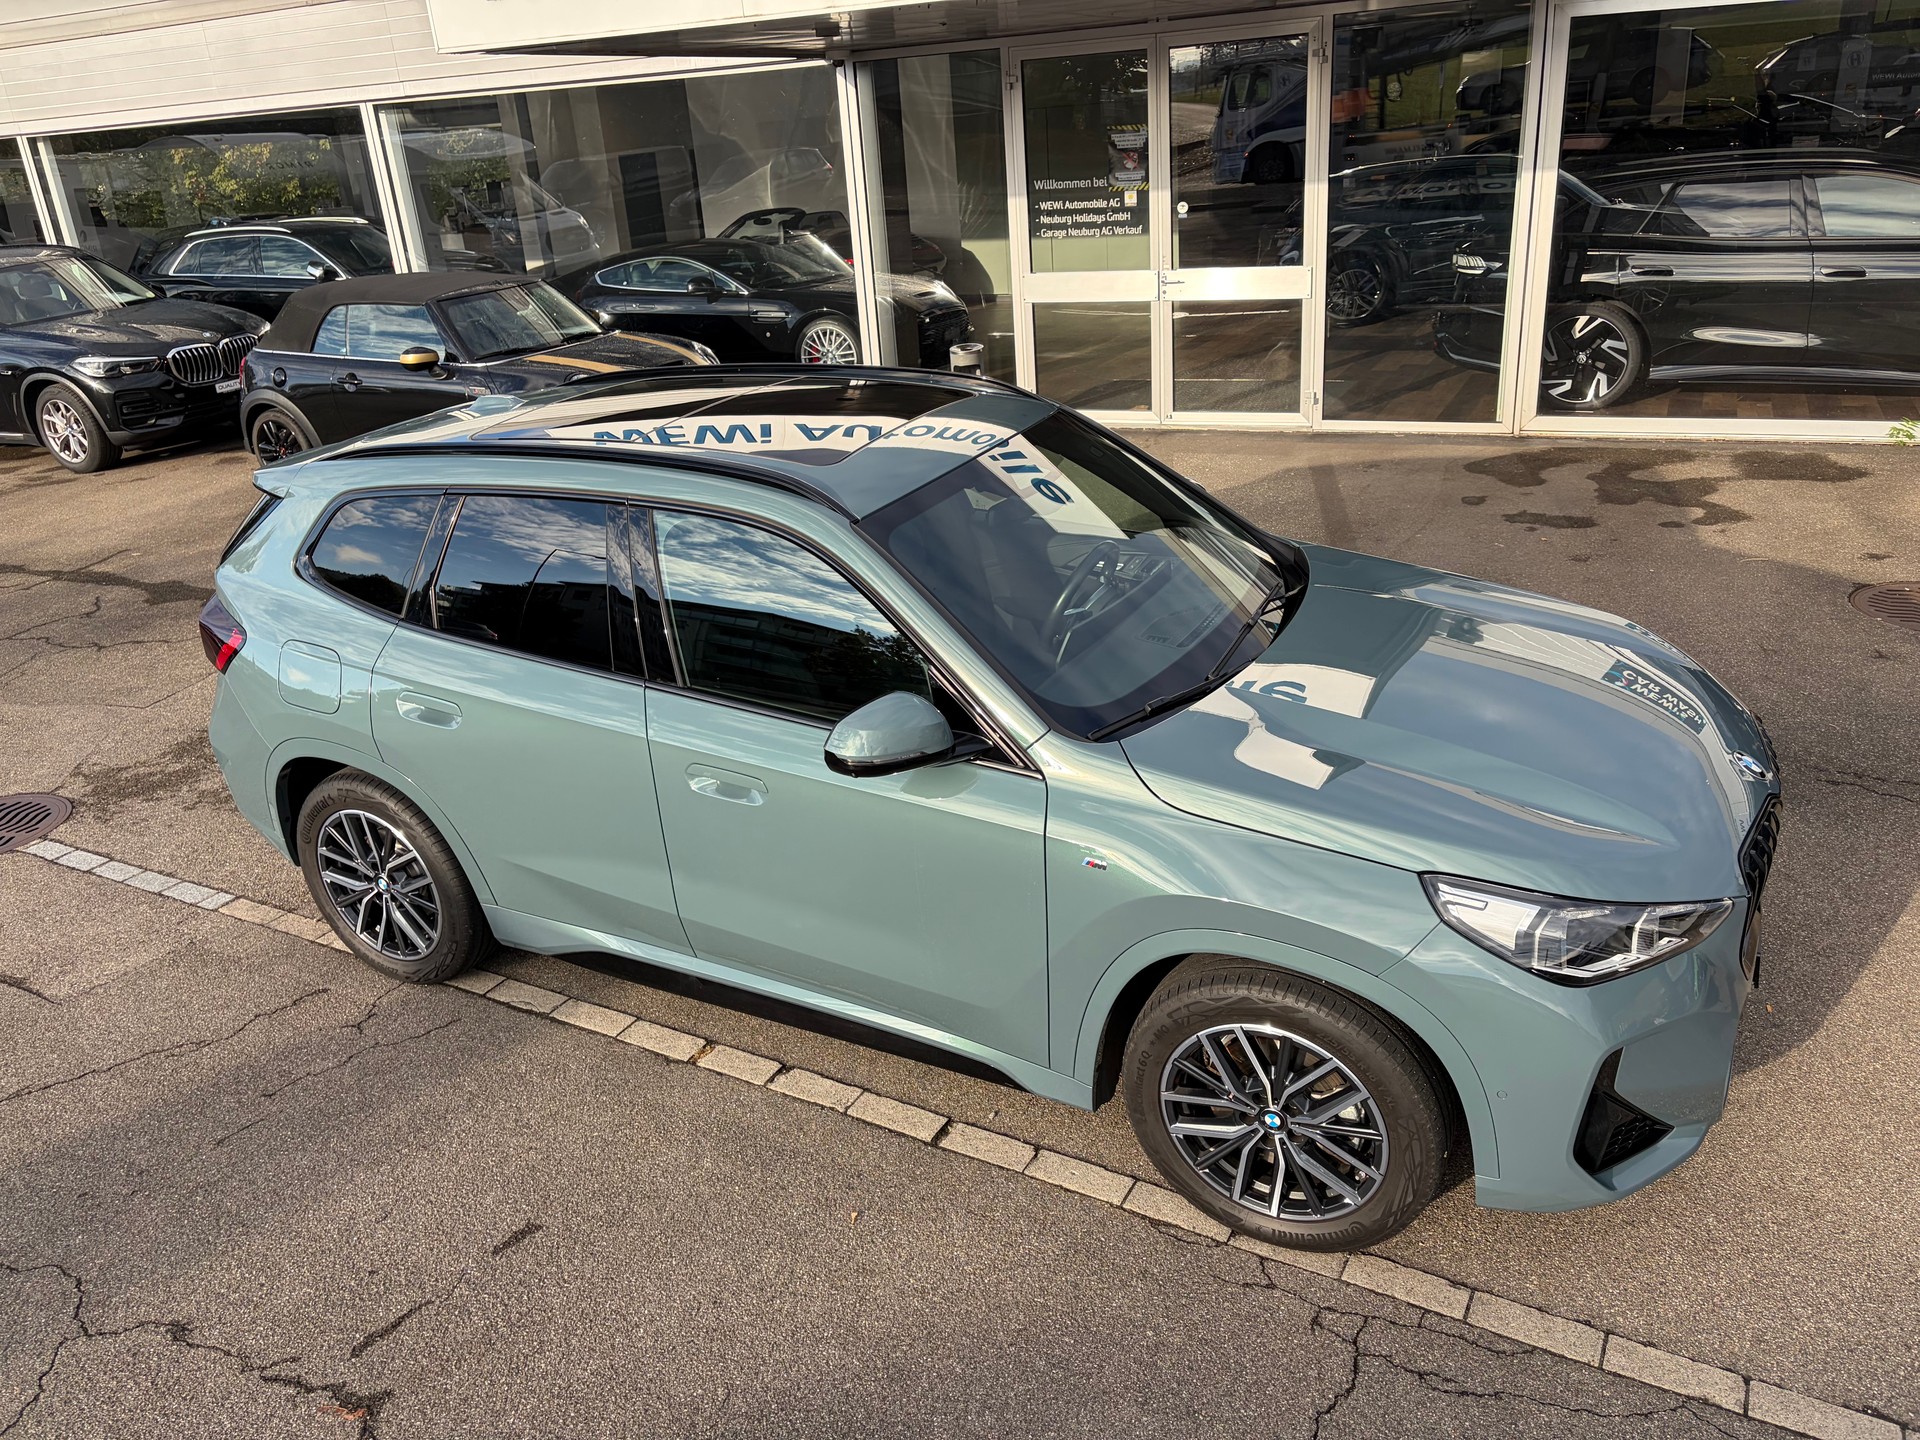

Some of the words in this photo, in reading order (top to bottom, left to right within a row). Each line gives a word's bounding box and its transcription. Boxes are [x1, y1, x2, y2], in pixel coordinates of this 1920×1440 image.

[1034, 178, 1092, 190] Willkommen
[1093, 177, 1108, 187] bei
[1039, 201, 1063, 210] WEWi
[1065, 199, 1108, 209] Automobile
[1109, 198, 1120, 208] AG
[1040, 215, 1071, 225] Neuburg
[1073, 213, 1105, 223] Holidays
[1107, 212, 1130, 222] GmbH
[1041, 228, 1067, 239] Garage
[1068, 227, 1099, 238] Neuburg
[1101, 226, 1112, 235] AG
[1113, 225, 1143, 235] Verkauf
